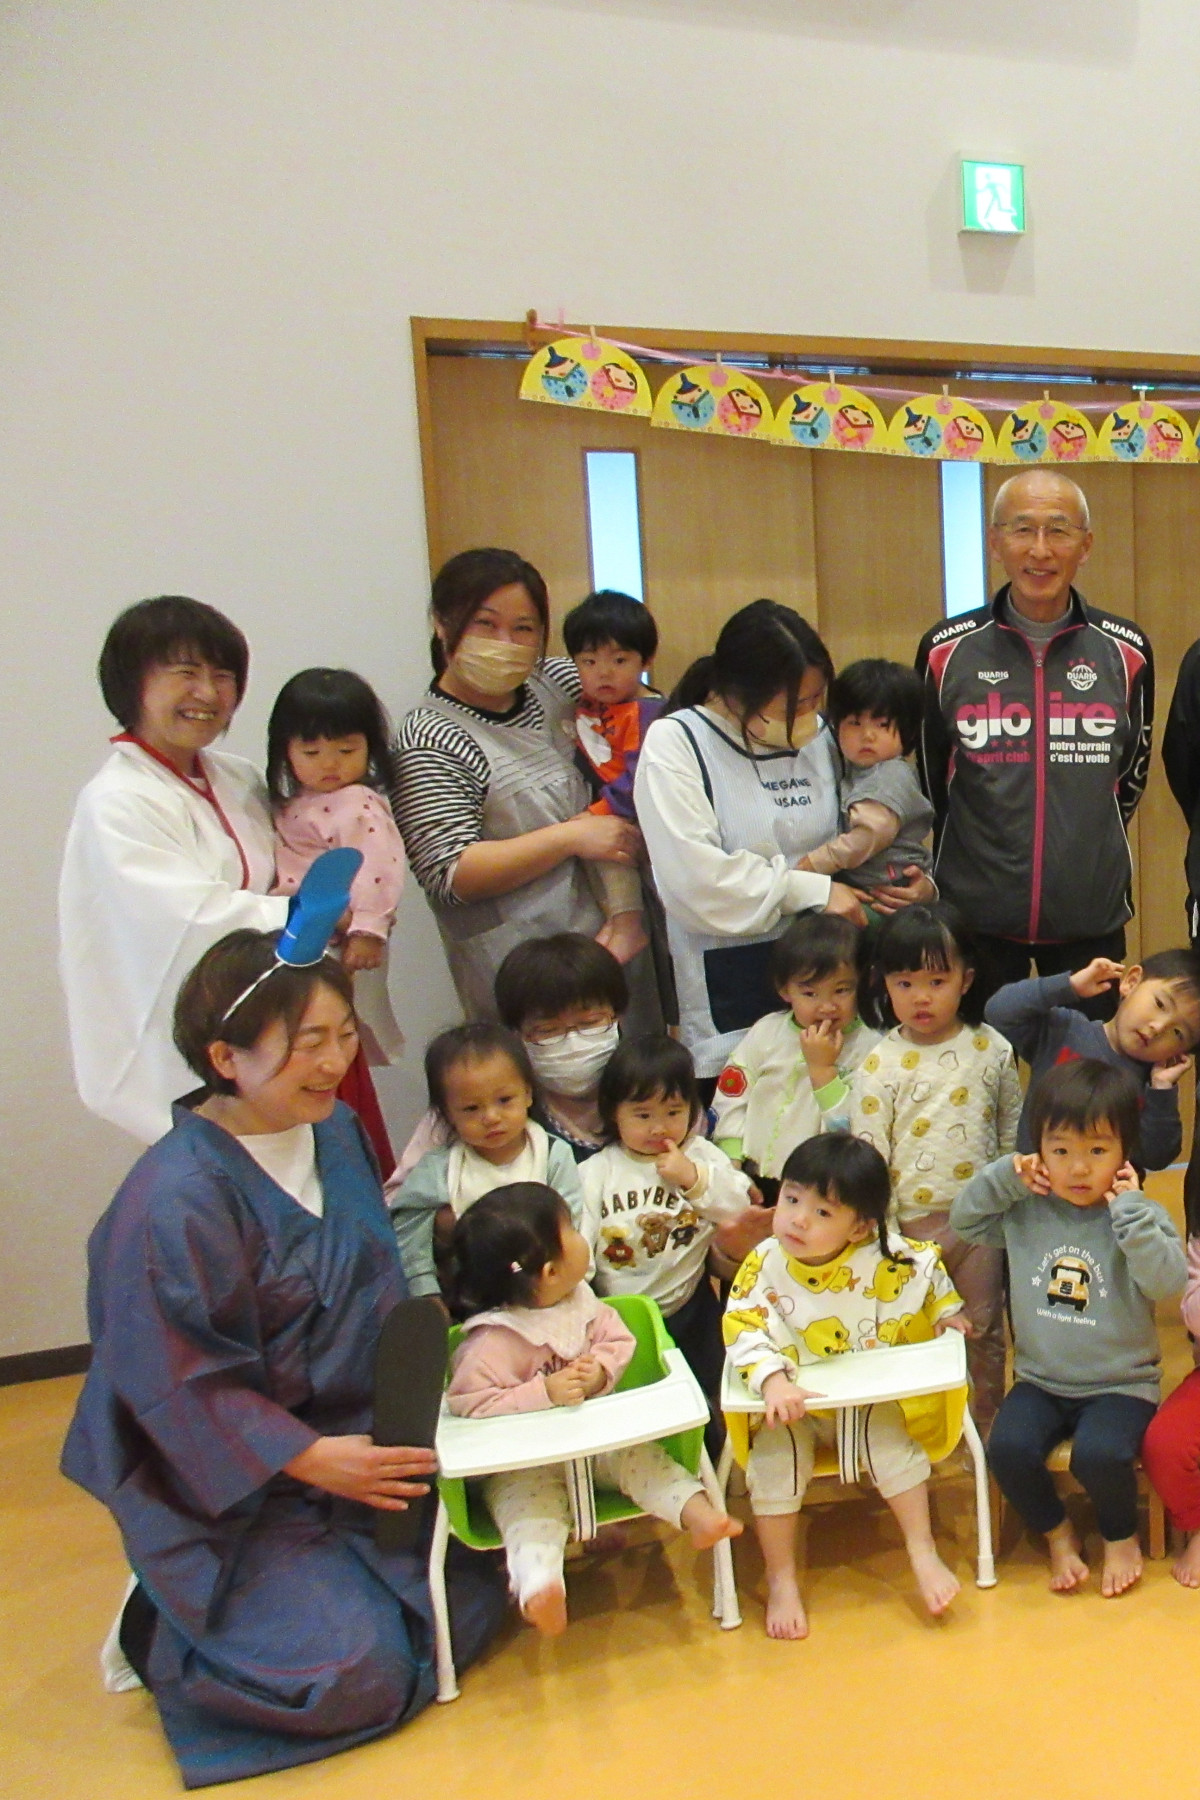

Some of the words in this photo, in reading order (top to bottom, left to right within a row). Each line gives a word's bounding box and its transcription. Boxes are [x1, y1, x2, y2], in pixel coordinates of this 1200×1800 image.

[931, 619, 977, 644] DUARIG
[1101, 619, 1144, 647] DUARIG
[978, 671, 1009, 679] DUARIG
[1066, 672, 1098, 680] DUARIG
[1050, 741, 1076, 752] notre
[1077, 741, 1111, 752] terrain
[1050, 752, 1073, 764] c'est
[761, 777, 812, 791] MEGANE
[774, 795, 812, 808] USAGI
[1053, 1244, 1067, 1257] get
[1068, 1245, 1080, 1255] on
[1081, 1249, 1095, 1266] the
[1093, 1263, 1105, 1283] bus
